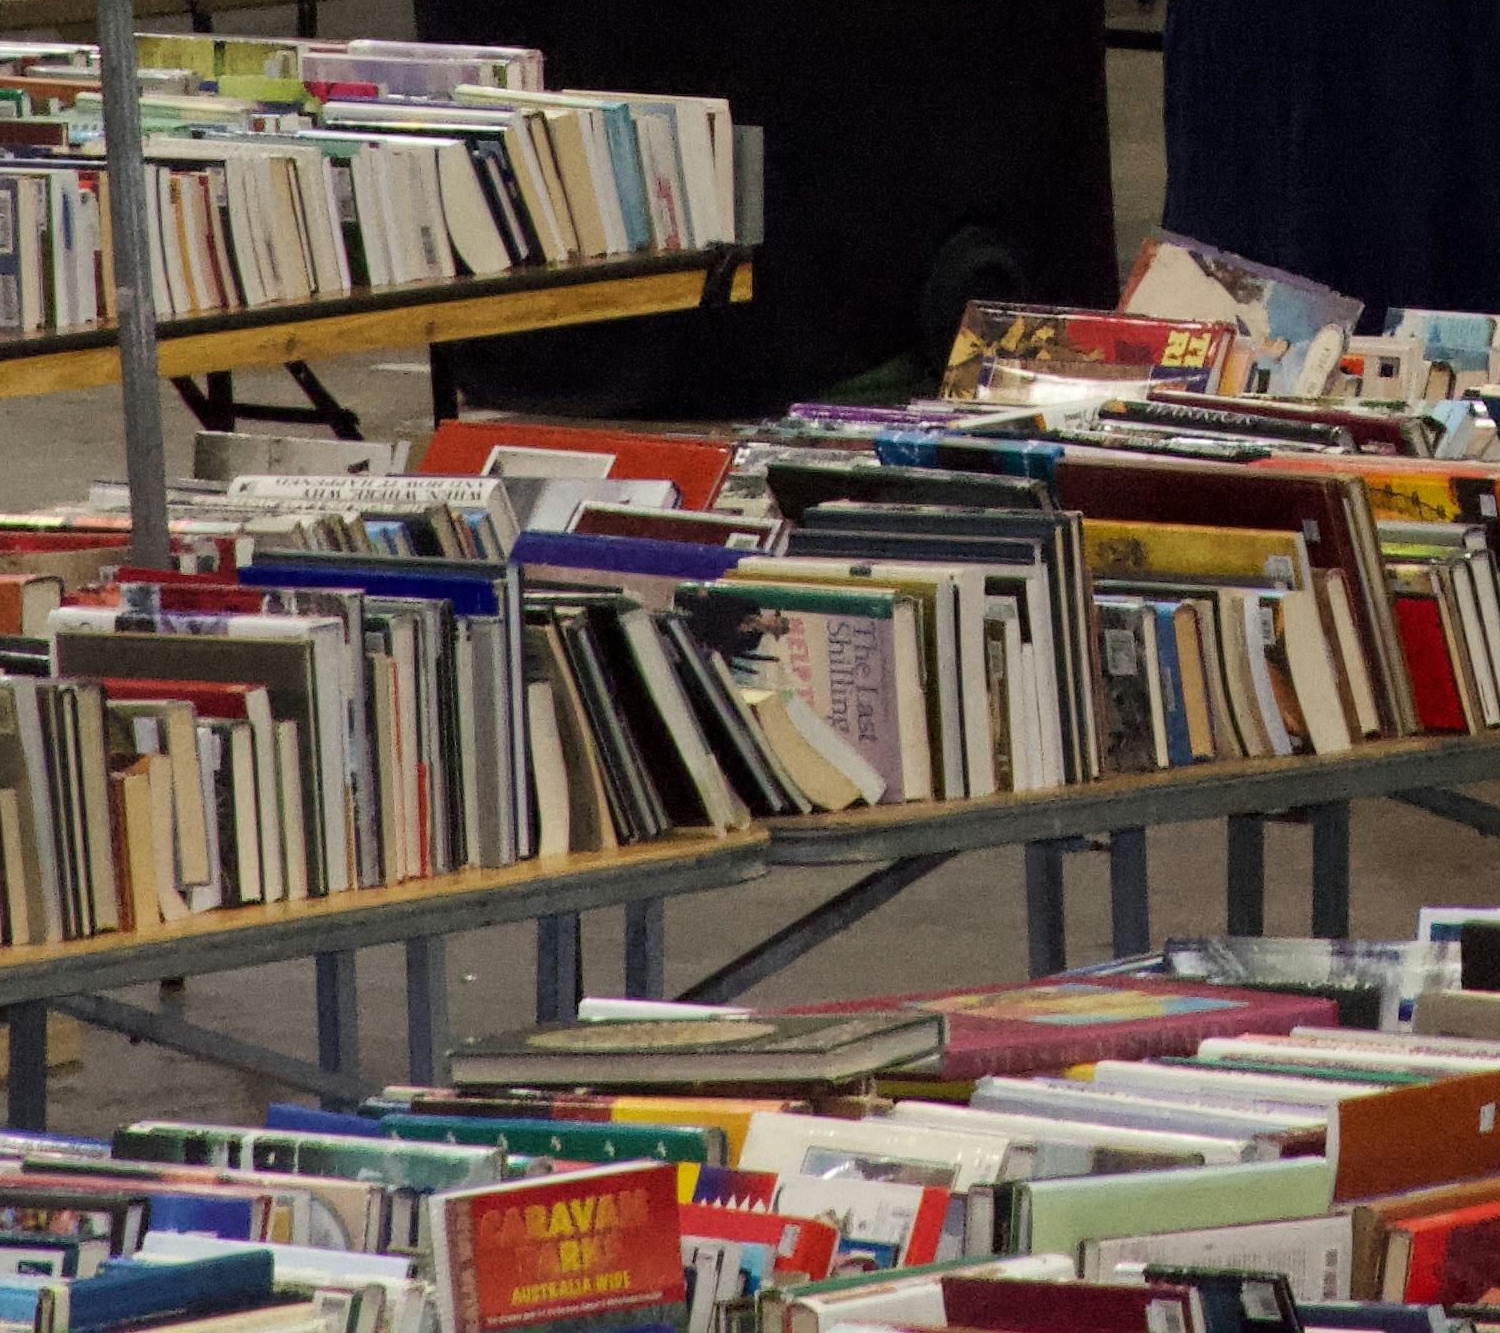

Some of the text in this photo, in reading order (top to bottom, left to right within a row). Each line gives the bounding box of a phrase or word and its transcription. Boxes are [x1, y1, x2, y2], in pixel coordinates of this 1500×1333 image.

[824, 620, 856, 733] Shilling
[852, 620, 879, 742] The Last
[479, 1188, 650, 1240] CARAVAN
